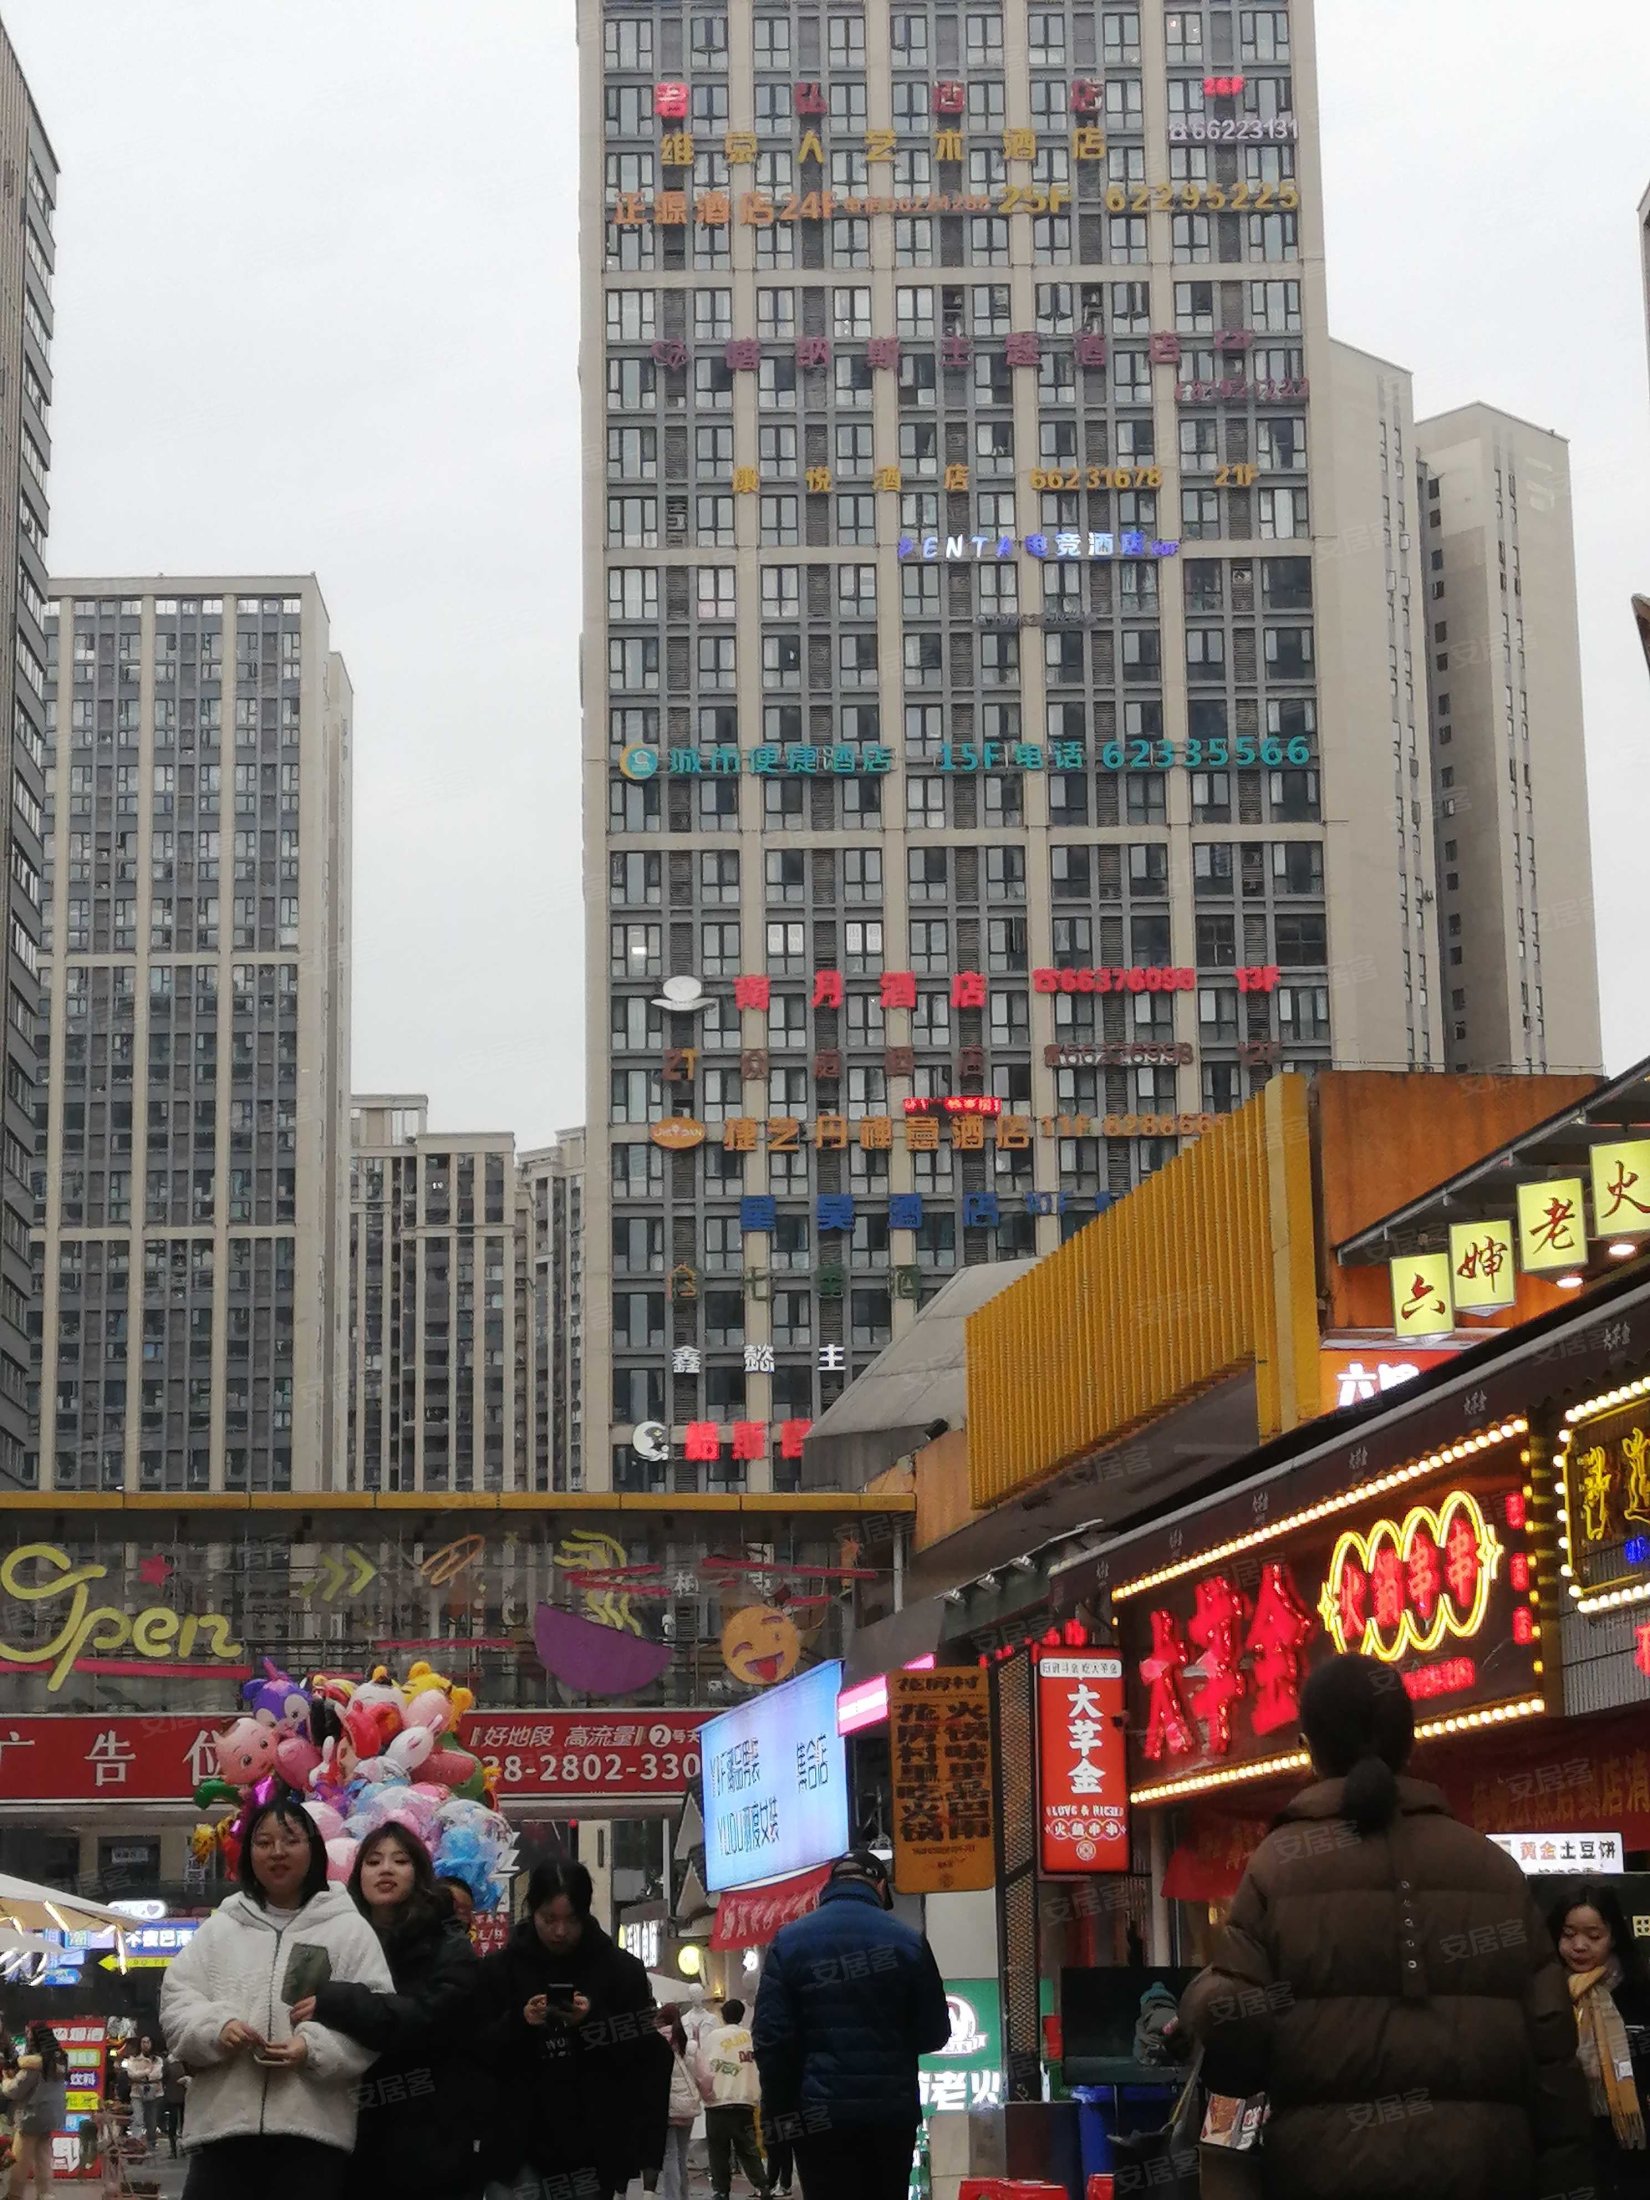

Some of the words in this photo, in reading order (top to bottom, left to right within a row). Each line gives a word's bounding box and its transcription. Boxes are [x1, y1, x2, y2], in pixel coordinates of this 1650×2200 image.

[1191, 118, 1298, 140] 66223131
[998, 184, 1072, 214] 25F
[1105, 182, 1299, 213] 62295225
[668, 743, 896, 775] 城市便捷酒店
[1102, 735, 1312, 770] 62335566
[1400, 1159, 1650, 1322] 六婶老火
[1066, 1683, 1106, 1794] 大芋金
